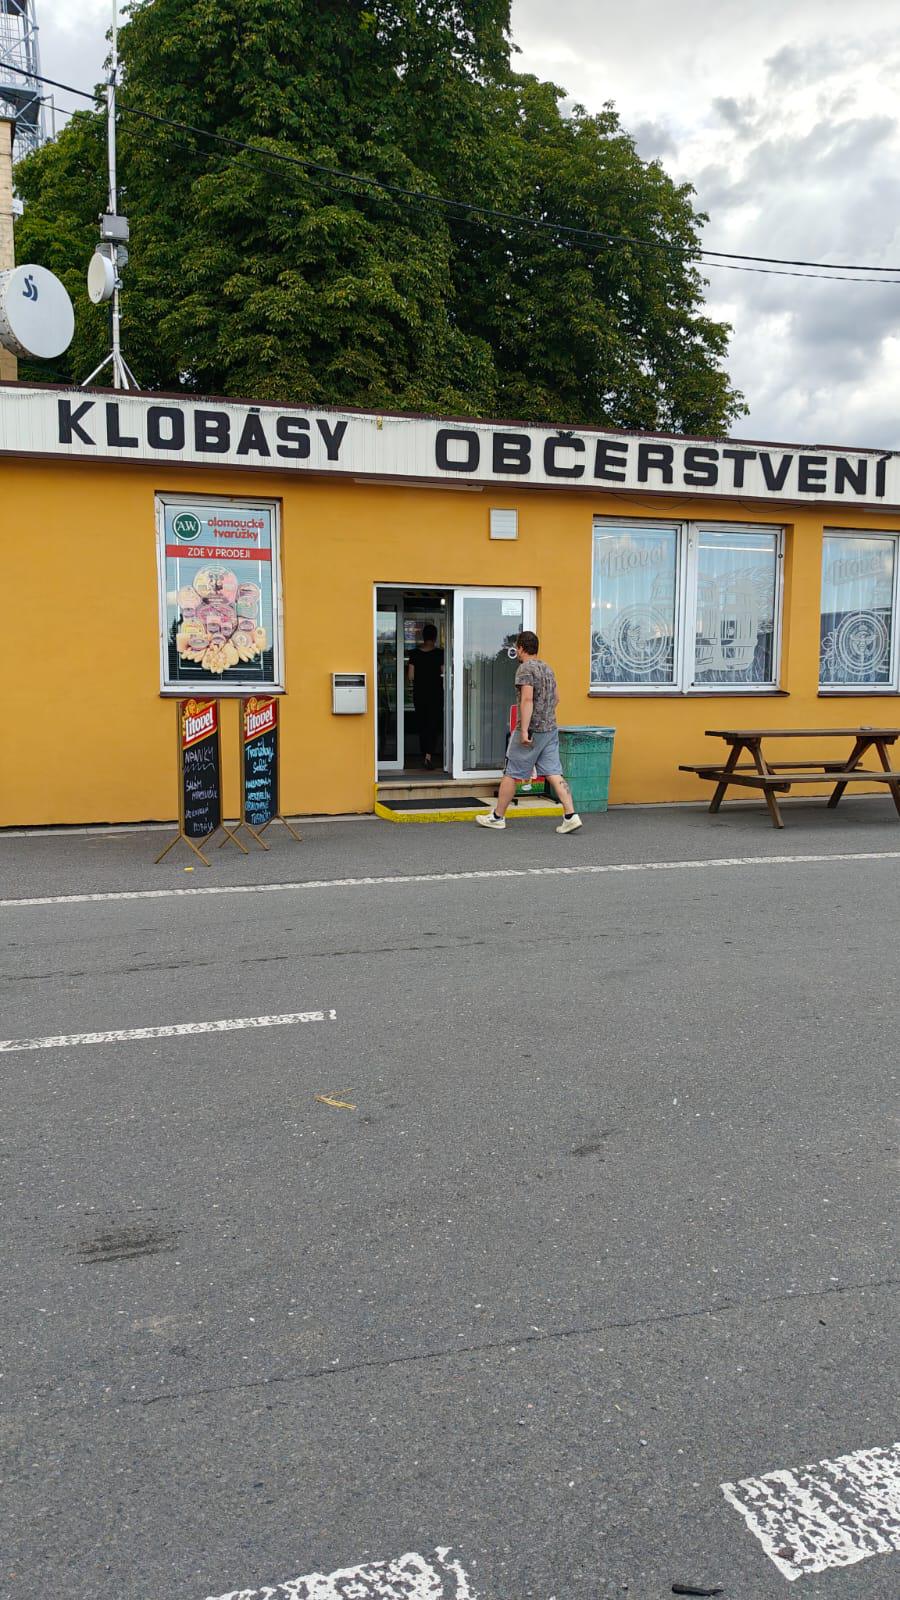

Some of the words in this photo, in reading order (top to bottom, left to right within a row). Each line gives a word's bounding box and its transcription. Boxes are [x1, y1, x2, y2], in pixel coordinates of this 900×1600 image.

[58, 399, 348, 461] KLOBÁSY
[435, 429, 892, 497] OBČERSTVENÍ
[208, 517, 264, 528] olomoucké
[187, 547, 205, 557] ZDE
[206, 548, 214, 557] V
[215, 549, 250, 558] PRODEJI
[185, 706, 213, 742] Litovel
[246, 704, 274, 737] Litovel
